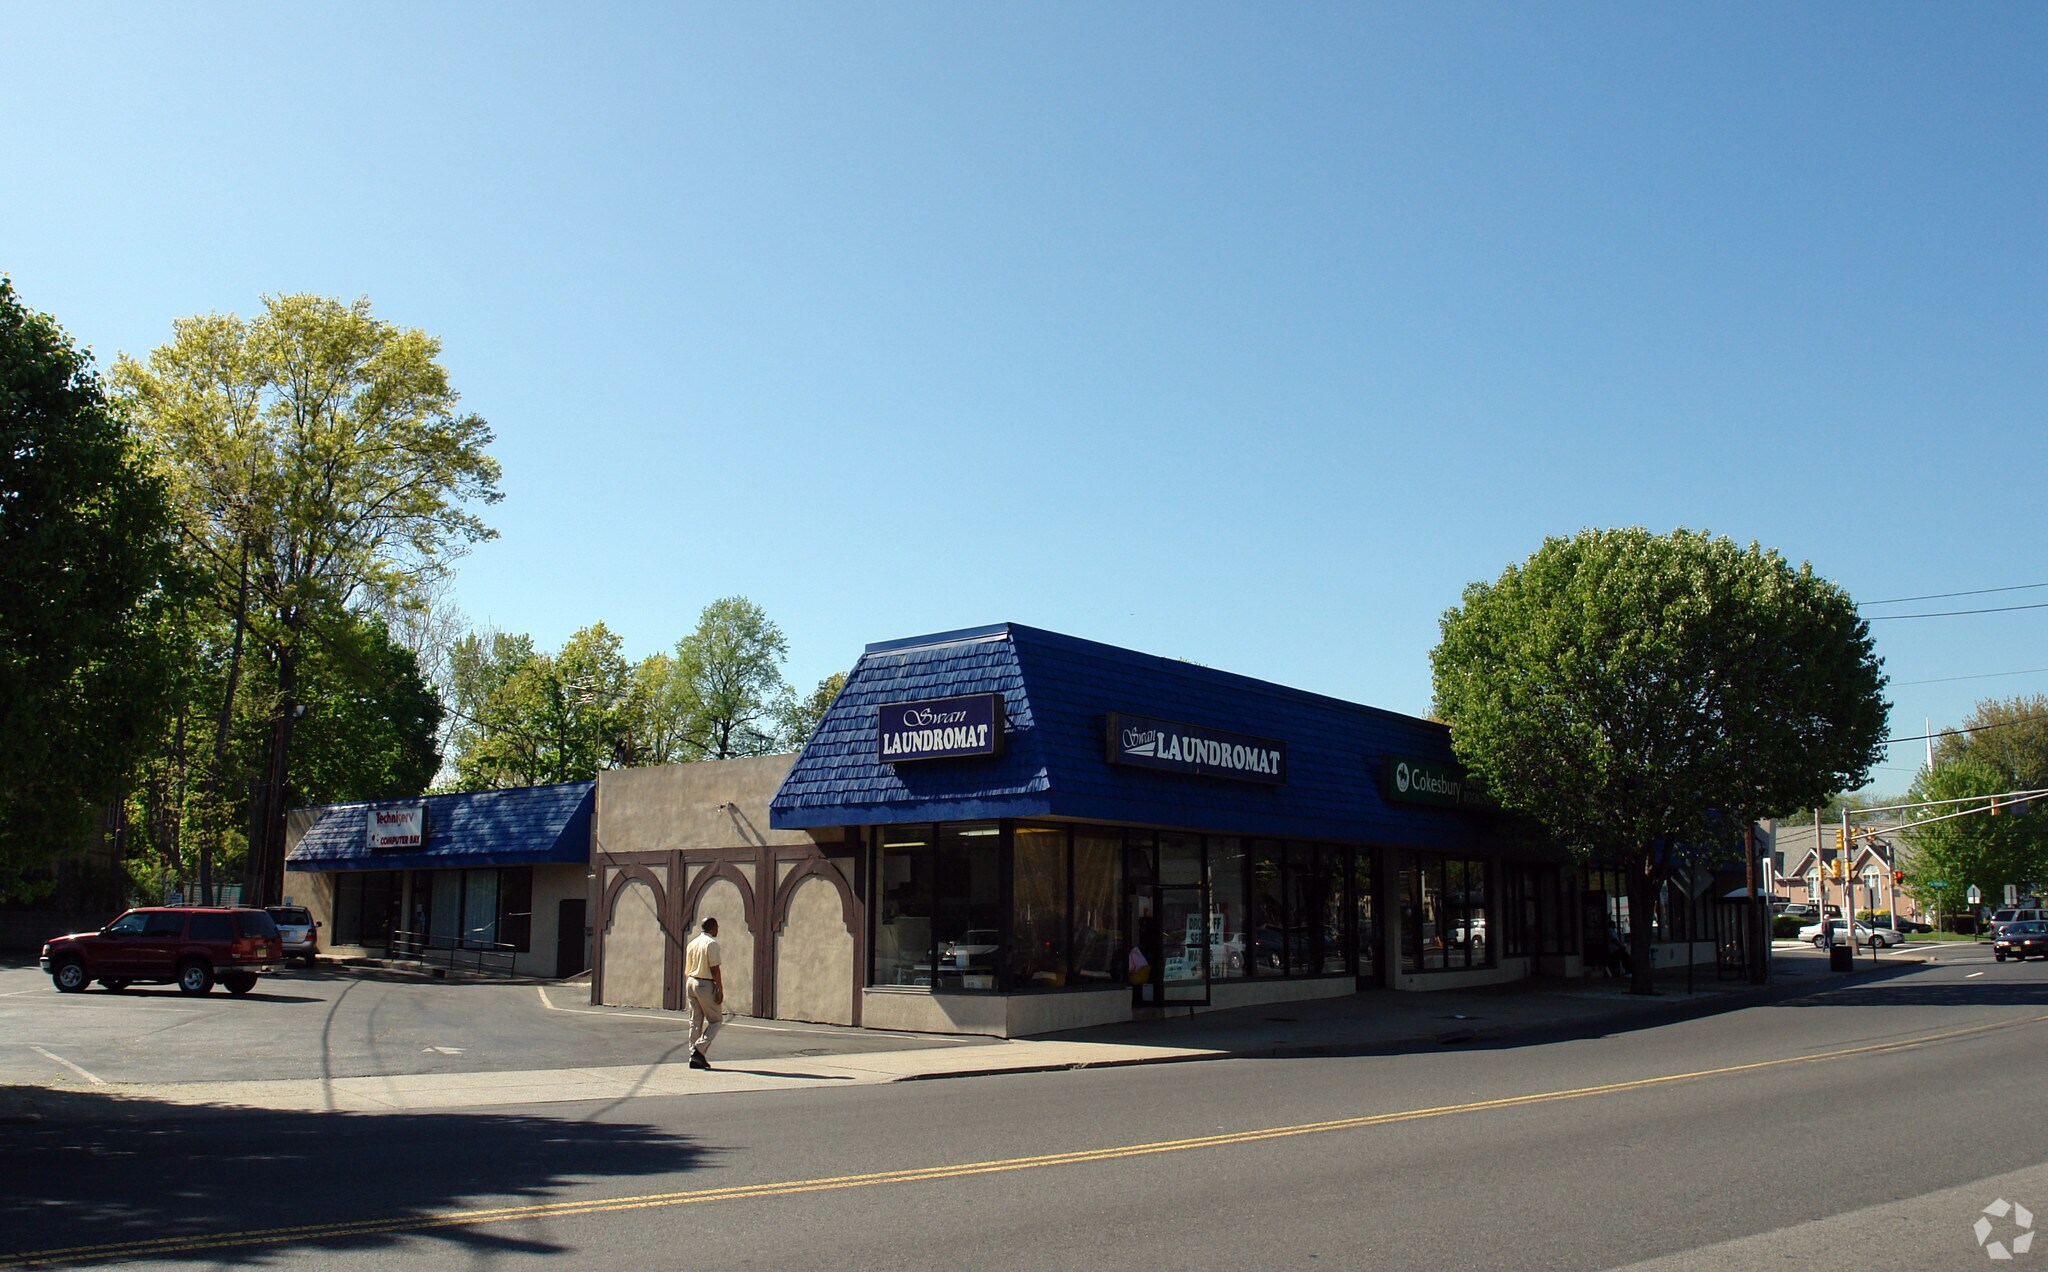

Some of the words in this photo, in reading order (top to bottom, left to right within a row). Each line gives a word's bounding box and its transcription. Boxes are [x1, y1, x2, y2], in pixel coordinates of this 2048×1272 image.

[903, 707, 967, 727] Swan
[883, 724, 988, 755] LAUNDROMAT
[1122, 727, 1157, 748] Swan
[1156, 732, 1280, 775] LAUNDROMAT
[1411, 768, 1461, 804] Cokesbury
[381, 836, 408, 845] COMPUTER
[410, 835, 420, 844] BAY
